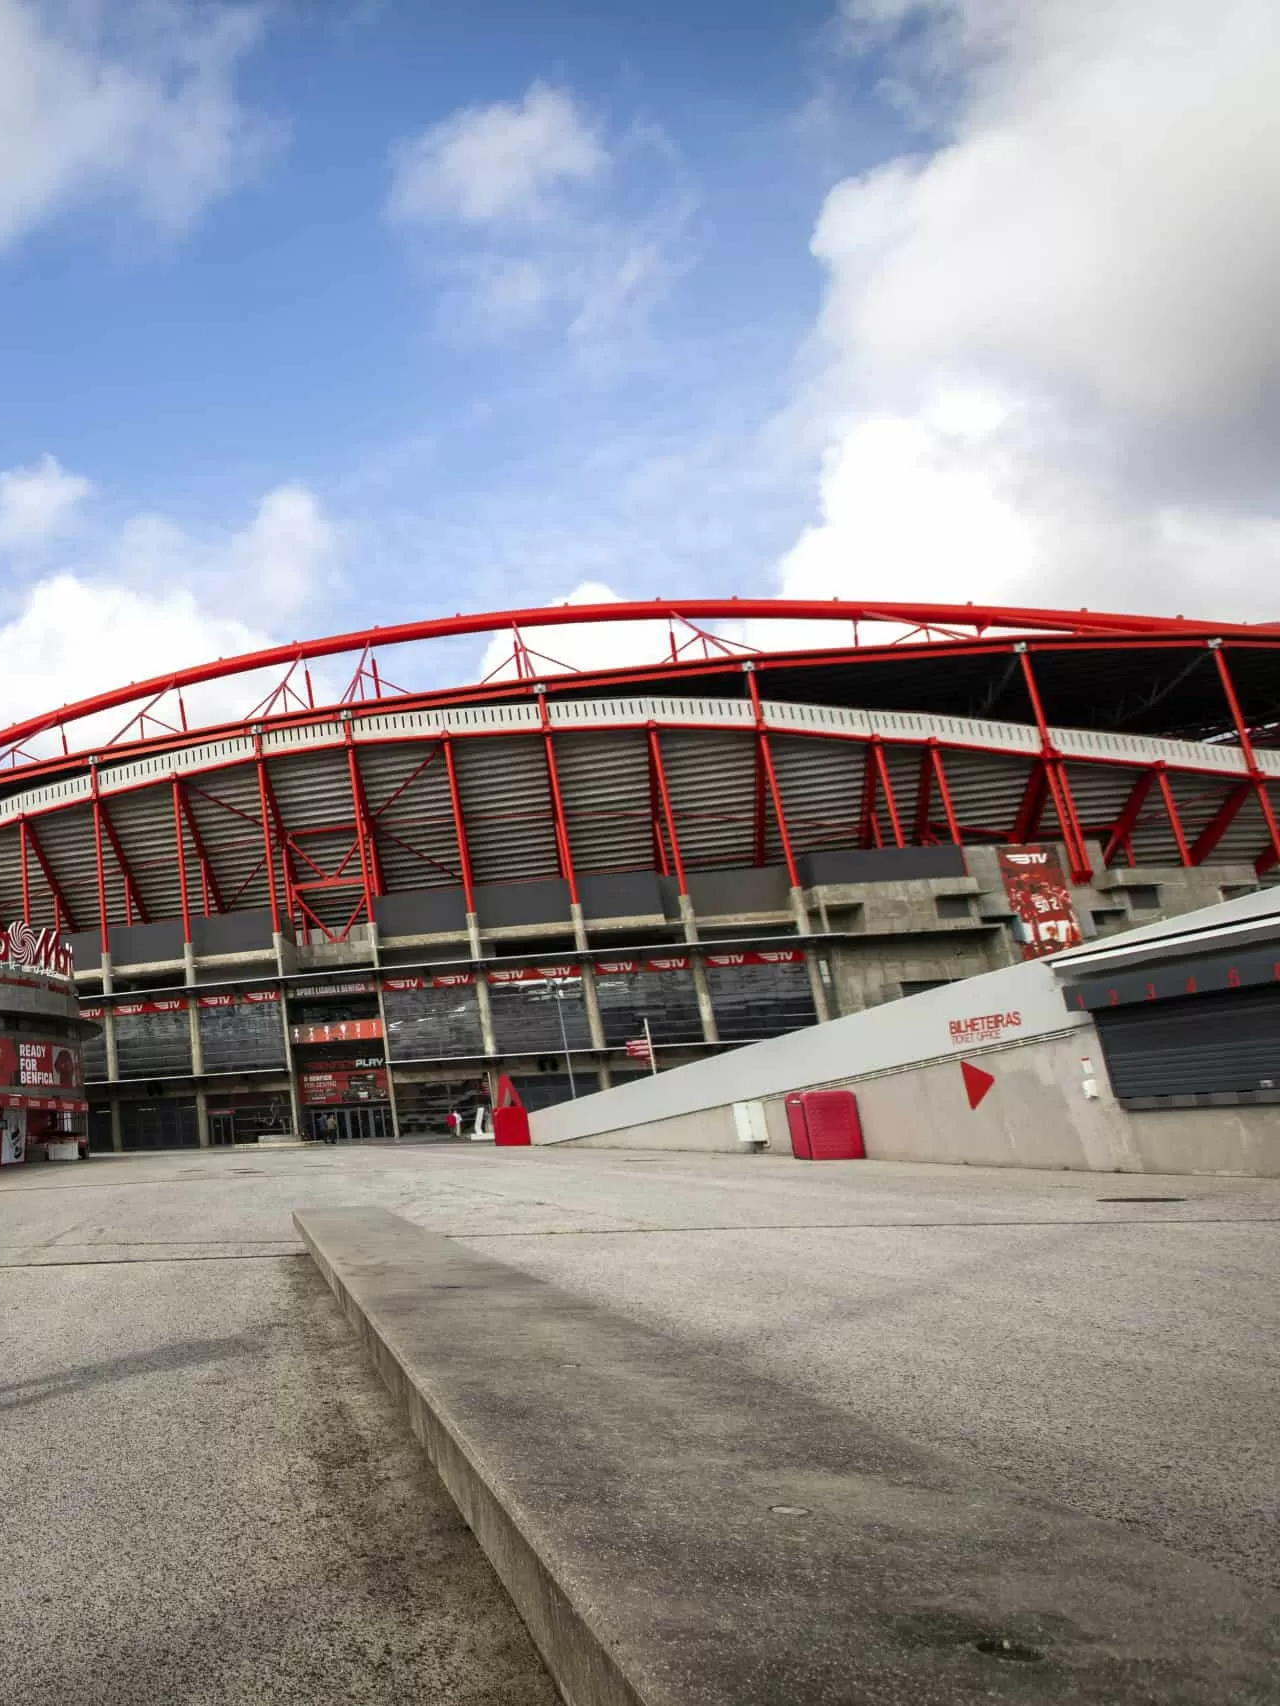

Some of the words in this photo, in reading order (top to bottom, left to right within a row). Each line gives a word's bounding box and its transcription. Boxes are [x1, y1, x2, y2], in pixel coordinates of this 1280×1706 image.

[1075, 994, 1085, 1009] 1
[1107, 989, 1118, 1006] 2
[1145, 983, 1156, 1000] 3
[1185, 976, 1196, 993] 4
[1227, 968, 1240, 987] 5
[949, 1011, 1021, 1034] BILHETEIRAS
[952, 1033, 975, 1045] TICKET
[20, 1044, 46, 1058] READY
[20, 1058, 37, 1071] FOR
[355, 1058, 384, 1068] PLAY
[20, 1071, 54, 1085] BENFICA
